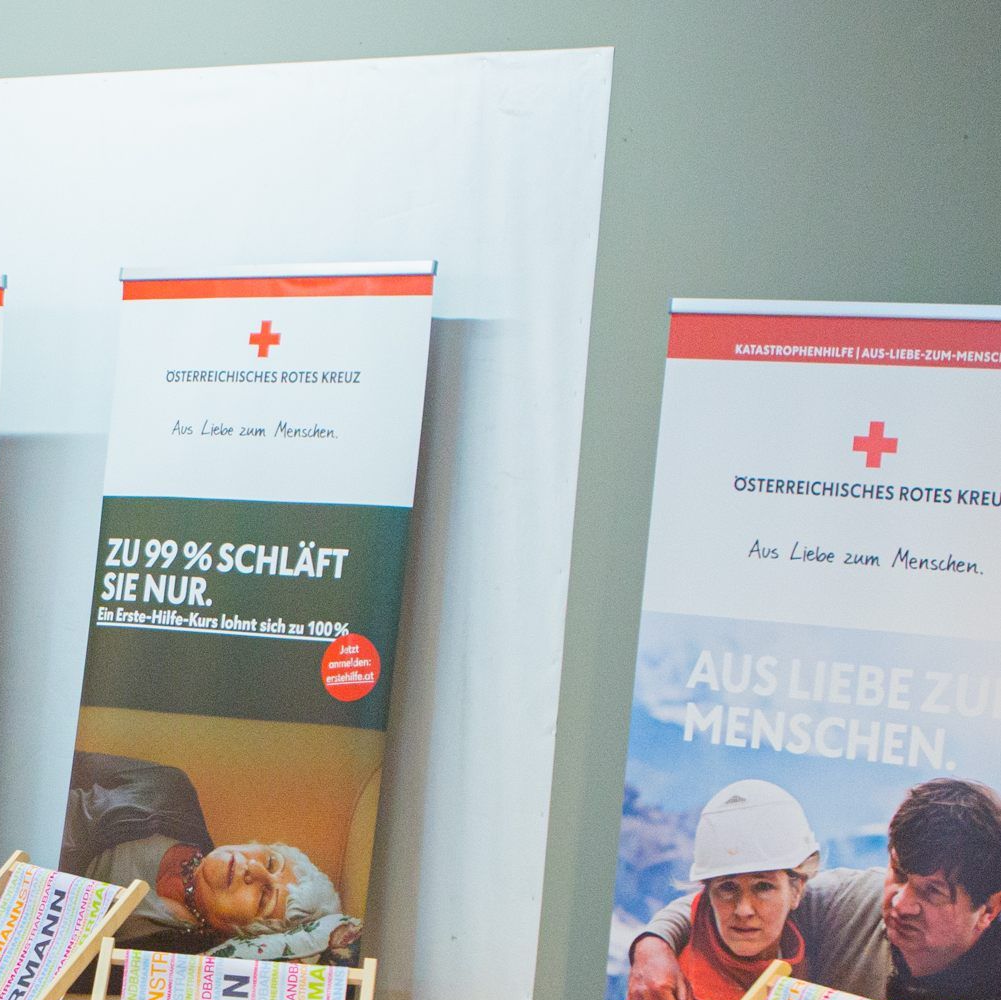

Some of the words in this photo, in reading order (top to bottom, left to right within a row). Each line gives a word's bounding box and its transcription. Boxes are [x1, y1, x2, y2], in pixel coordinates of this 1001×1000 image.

[734, 344, 854, 359] KATASTROPHENHILFE
[861, 347, 1001, 363] AUS-LIEBE-ZUM-MENSC
[166, 369, 278, 384] ÖSTERREICHISCHES
[280, 371, 318, 384] ROTES
[321, 371, 361, 384] KREUZ
[172, 419, 193, 436] Aus
[200, 419, 234, 437] Liebe
[239, 426, 266, 438] zum
[274, 421, 339, 440] Menschen.
[734, 475, 895, 501] ÖSTERREICHISCHES
[898, 486, 953, 504] ROTES
[105, 537, 140, 567] ZU
[216, 540, 350, 579] SCHLÄFT
[747, 539, 779, 560] Aus
[789, 541, 836, 564] Liebe
[843, 552, 881, 567] zum
[891, 547, 984, 576] Menschen.
[101, 571, 140, 602] SIE
[143, 574, 213, 607] NUR.
[97, 606, 114, 622] Ein
[115, 607, 219, 630] Erste-Hilfe-Kurs
[220, 614, 258, 632] lohnt
[259, 619, 286, 635] sich
[287, 623, 305, 636] zu
[686, 650, 779, 697] AUS
[788, 658, 917, 710] LIEBE
[682, 702, 958, 772] MENSCHEN.
